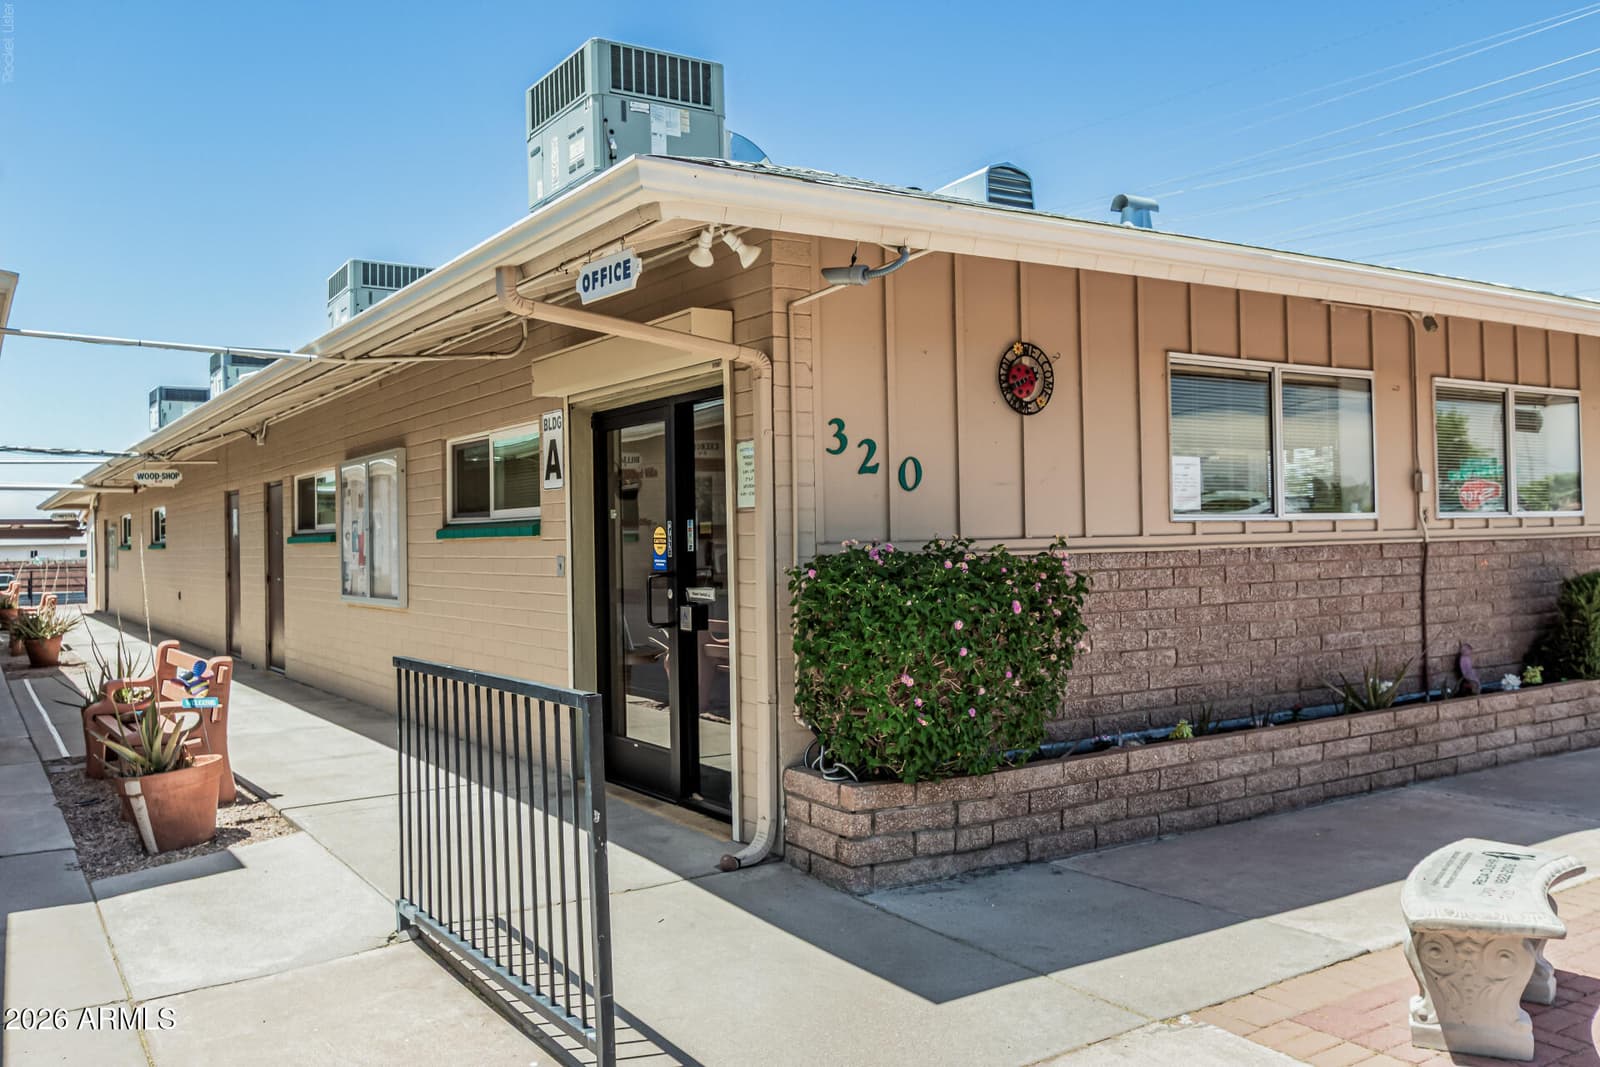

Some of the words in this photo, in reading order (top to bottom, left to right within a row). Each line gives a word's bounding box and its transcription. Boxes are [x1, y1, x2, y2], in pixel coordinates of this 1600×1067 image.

[582, 258, 631, 293] OFFICE
[543, 416, 562, 431] BLDG
[545, 438, 562, 481] A
[825, 417, 923, 492] 320
